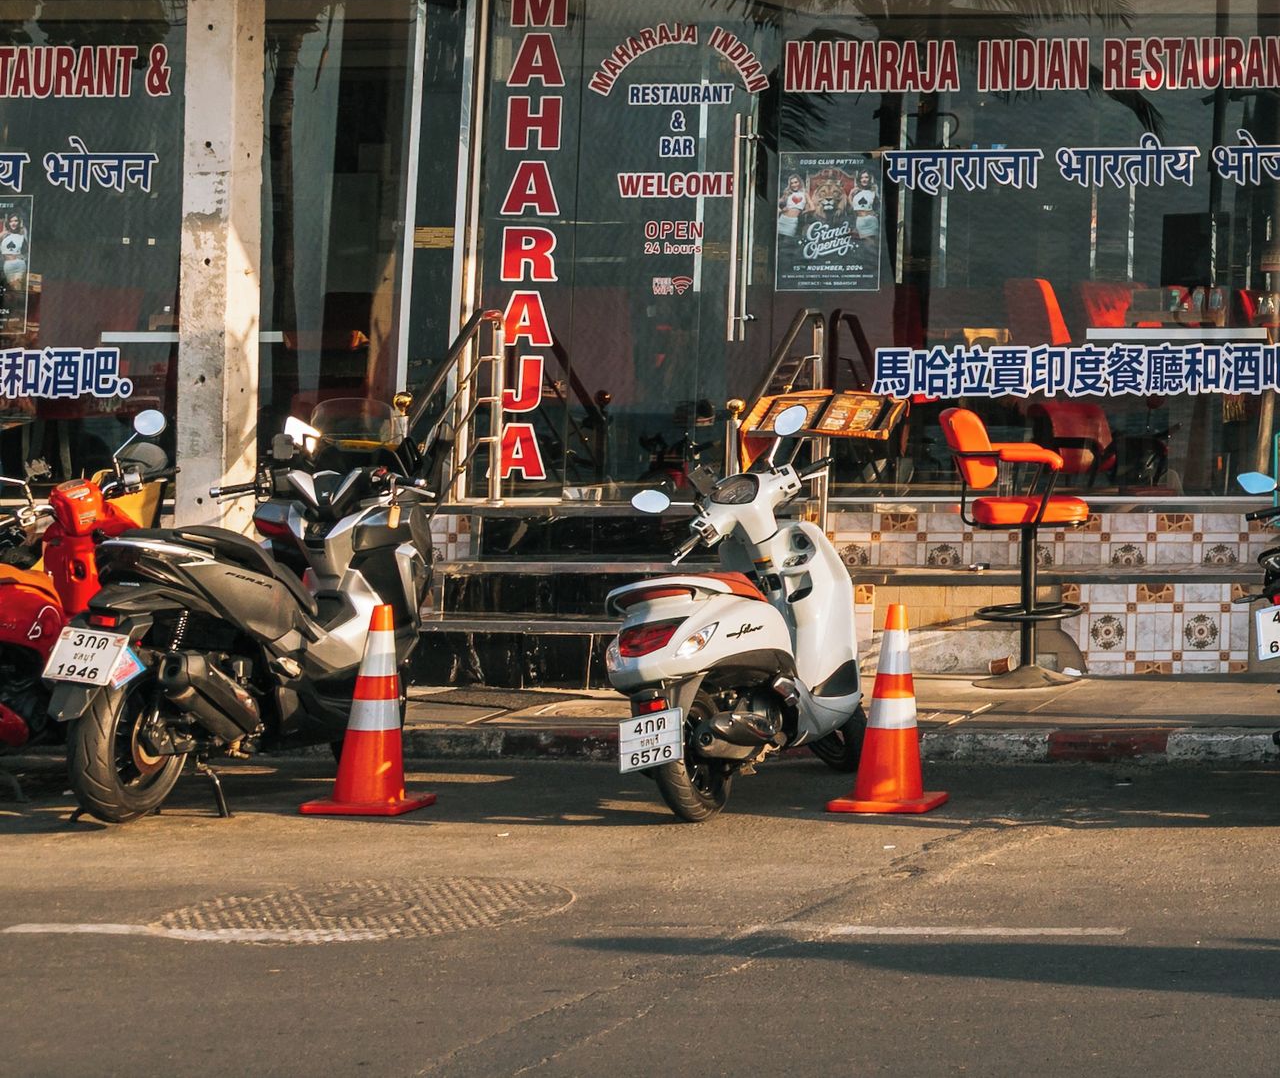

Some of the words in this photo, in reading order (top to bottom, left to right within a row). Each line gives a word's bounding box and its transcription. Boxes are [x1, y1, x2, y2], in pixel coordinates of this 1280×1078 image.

[145, 43, 171, 97] &
[588, 22, 698, 97] MAHARAJA
[707, 26, 770, 93] INDIAN
[784, 39, 959, 93] MAHARAJA
[977, 37, 1089, 91] INDIAN
[628, 83, 734, 105] RESTAURANT
[670, 110, 686, 132] &
[659, 136, 695, 158] BAR
[43, 135, 160, 193] भोजन
[882, 148, 1044, 195] महाराजा
[1056, 132, 1200, 189] भारतीय
[618, 172, 734, 198] WELCOME
[644, 220, 704, 239] OPEN
[806, 221, 850, 242] Grand
[644, 243, 660, 254] 24
[664, 242, 703, 254] hours
[803, 236, 853, 259] Opening
[0, 346, 134, 399] 和酒吧。
[225, 571, 273, 590] FORZA
[58, 663, 99, 680] 1946
[630, 745, 673, 766] 6576
